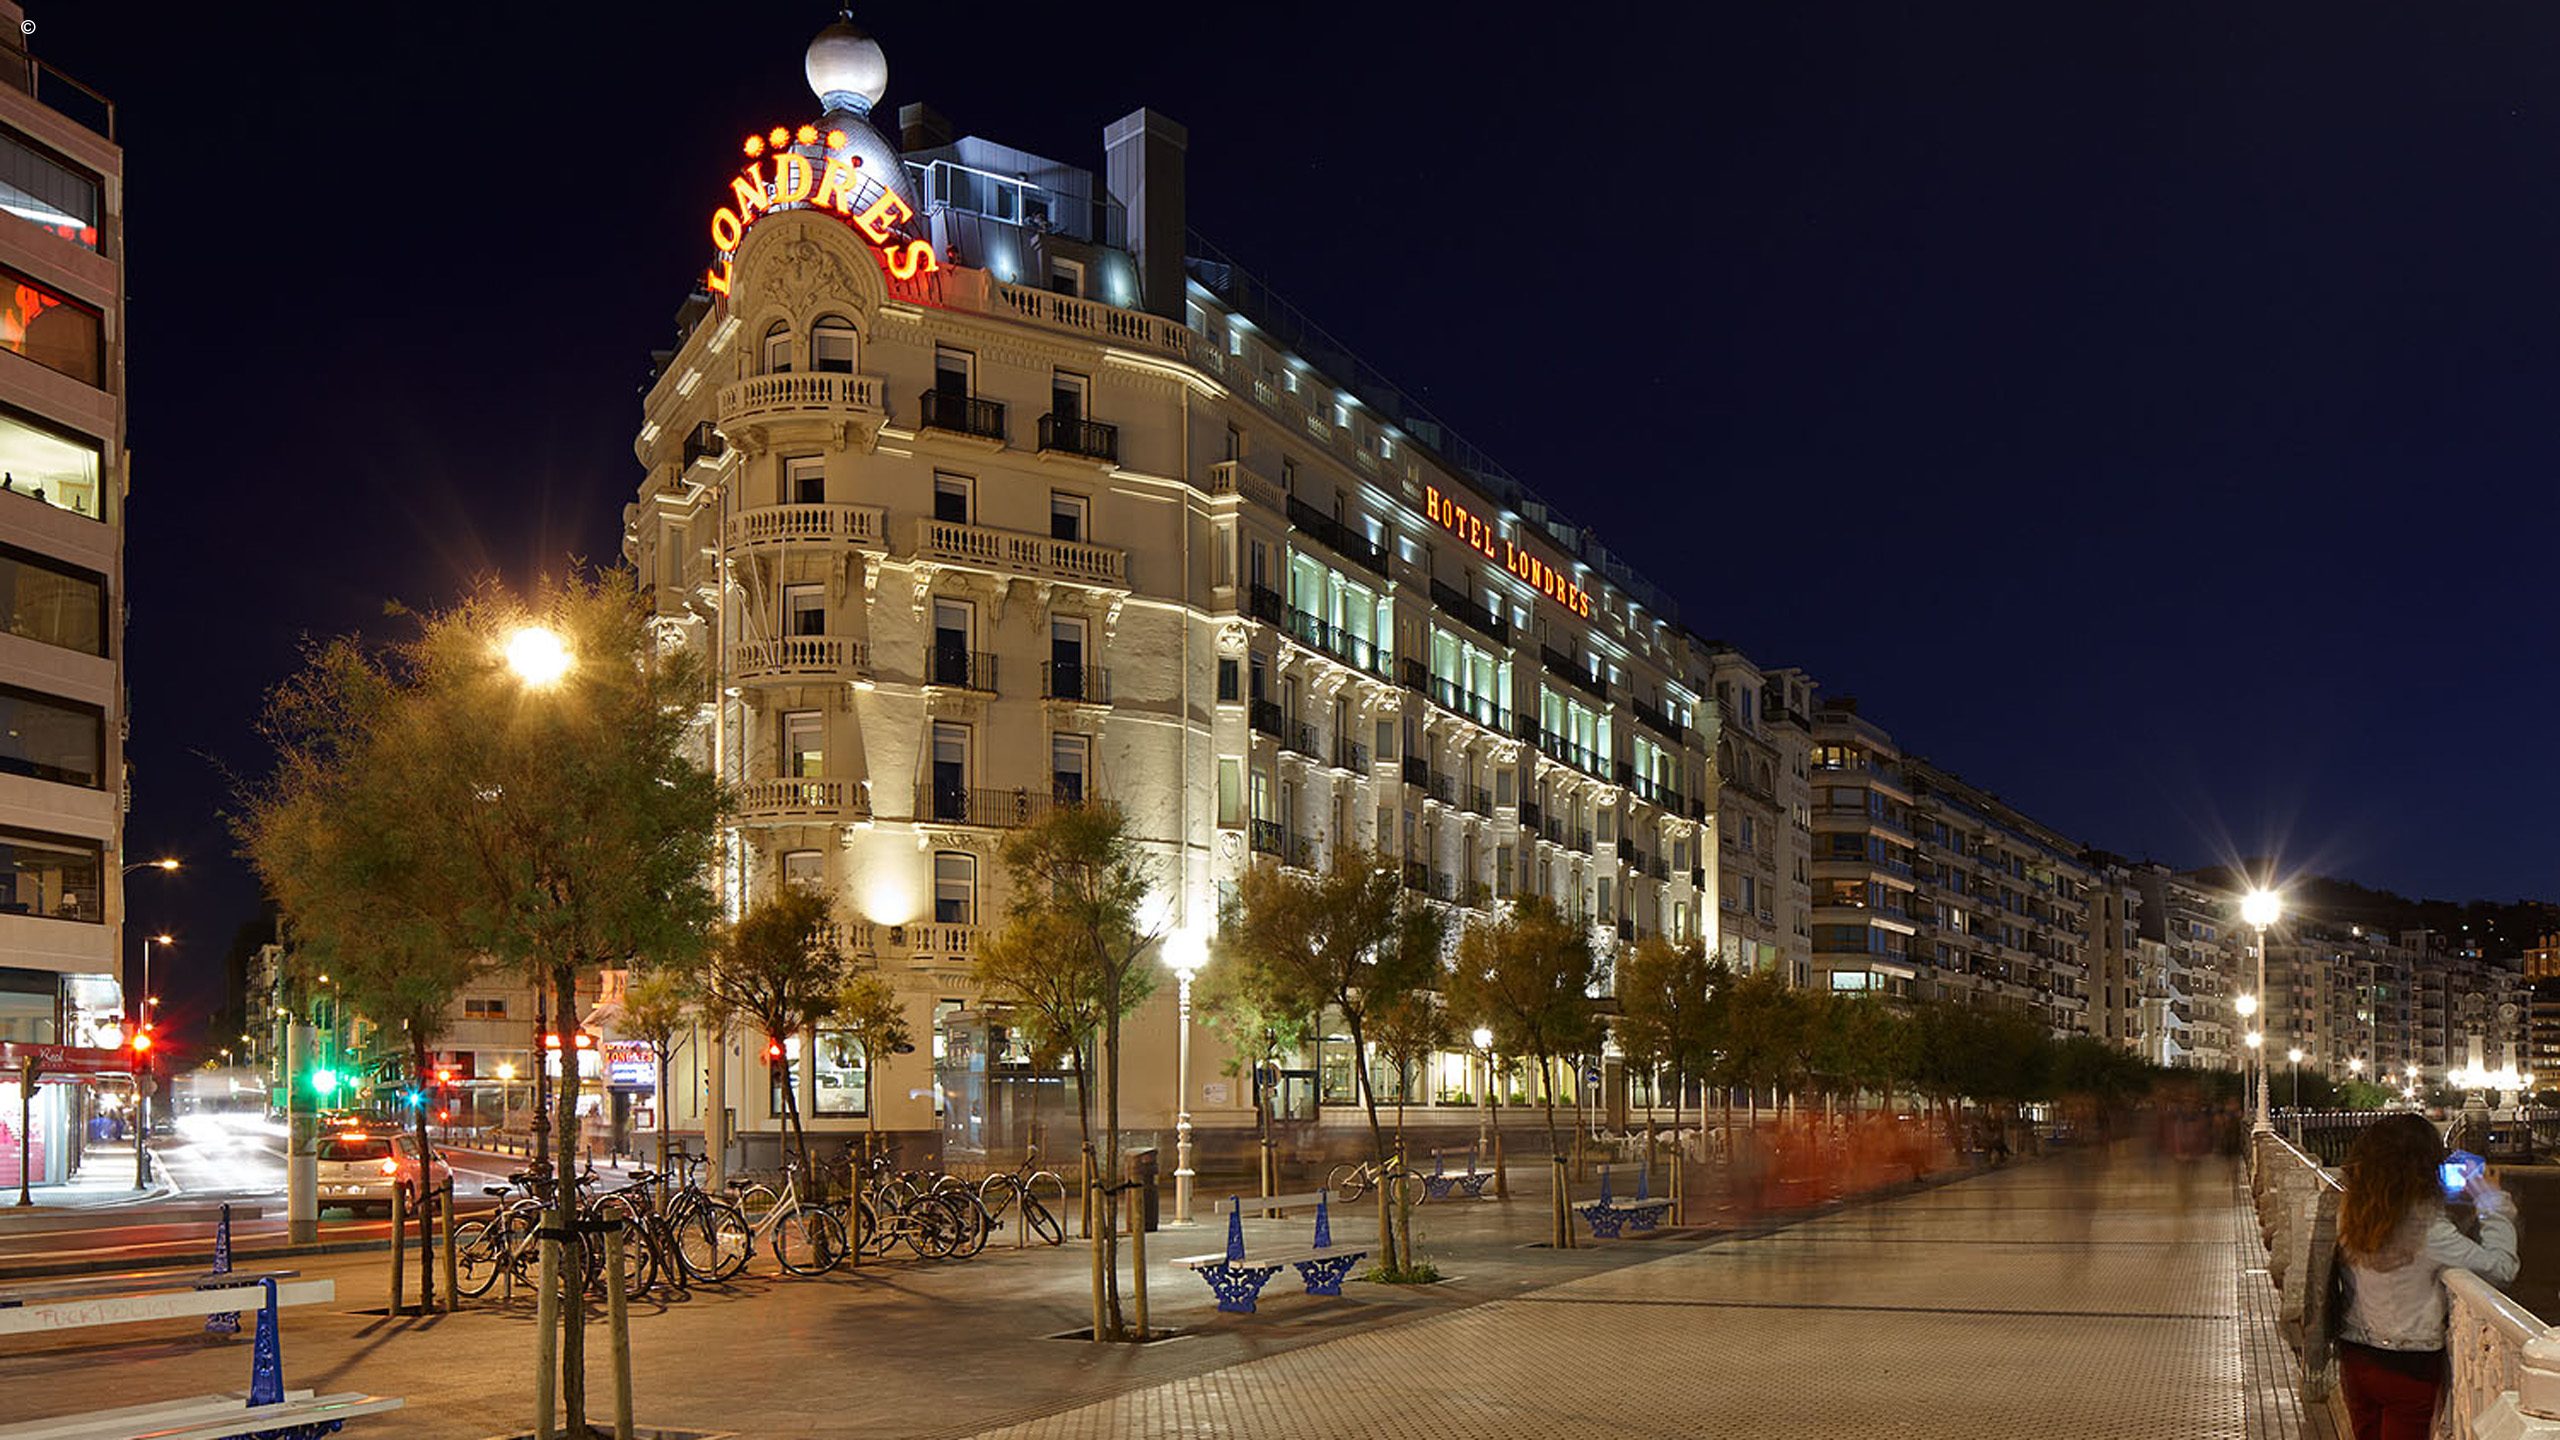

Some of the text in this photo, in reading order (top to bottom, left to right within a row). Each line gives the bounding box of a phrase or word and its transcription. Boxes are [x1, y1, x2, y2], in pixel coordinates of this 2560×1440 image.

[707, 152, 939, 297] LONDRES
[1426, 485, 1591, 619] HOTEL LONDRES
